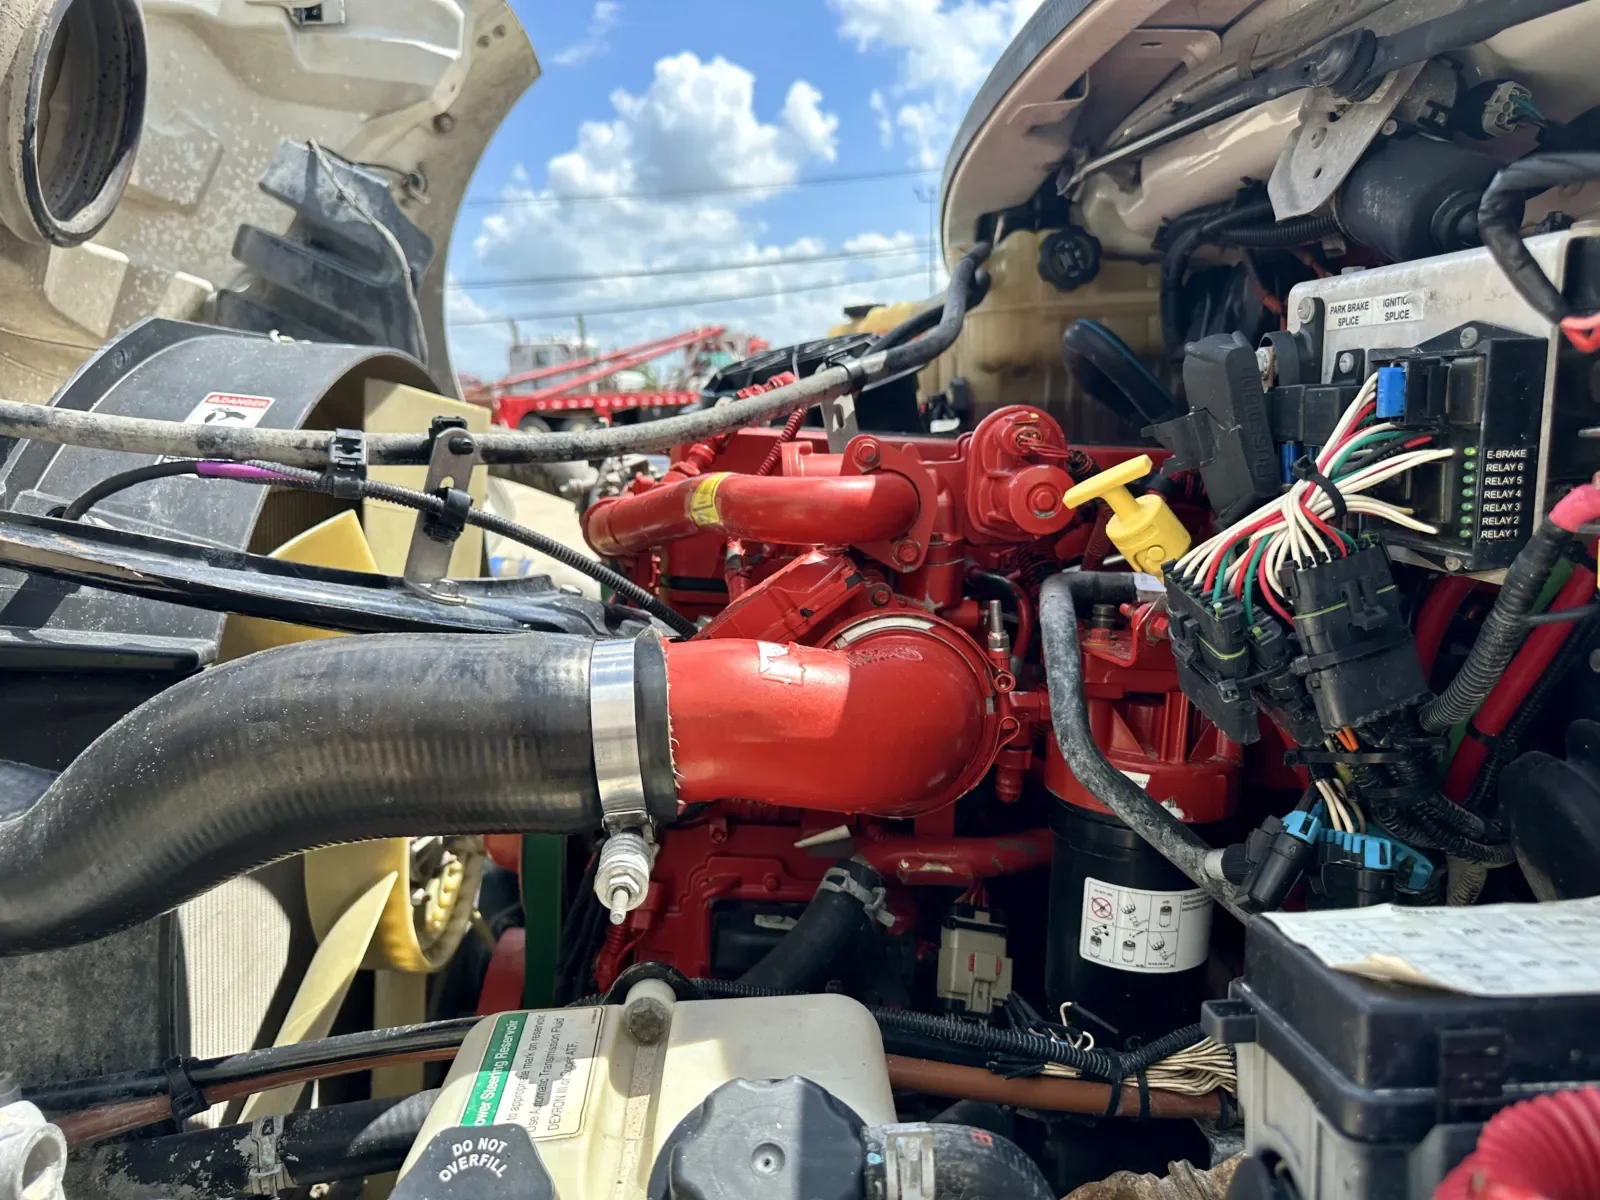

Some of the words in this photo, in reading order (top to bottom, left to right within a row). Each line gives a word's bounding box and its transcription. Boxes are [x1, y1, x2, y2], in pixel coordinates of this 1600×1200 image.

[1383, 295, 1410, 308] IGNITIO
[1330, 304, 1346, 315] PARK
[1348, 301, 1369, 312] BRAKE
[1338, 315, 1359, 327] SPLICE
[1385, 309, 1410, 321] SPLICE
[221, 397, 267, 407] DANGER
[1486, 449, 1527, 459] E-BRAKE
[1486, 463, 1516, 472] RELAY
[1517, 463, 1523, 471] 6
[1485, 476, 1515, 485] RELAY
[1516, 476, 1523, 485] 5
[1484, 490, 1514, 499] RELAY
[1515, 490, 1521, 498] 4
[1483, 503, 1513, 512] RELAY
[1514, 503, 1520, 511] 3
[1482, 516, 1512, 525] RELAY
[1513, 516, 1519, 525] 2
[1481, 530, 1511, 538] RELAY
[480, 1059, 508, 1100] Steering
[494, 1020, 518, 1058] Reservoir
[523, 1051, 535, 1070] mark
[529, 1041, 537, 1050] on
[528, 1115, 540, 1132] Use
[539, 1033, 560, 1077] Transmission
[551, 1018, 565, 1034] Fluid
[548, 1095, 566, 1131] DEXRON
[452, 1139, 473, 1157] DO
[477, 1137, 508, 1154] NOT
[439, 1153, 508, 1183] OVERFILL
